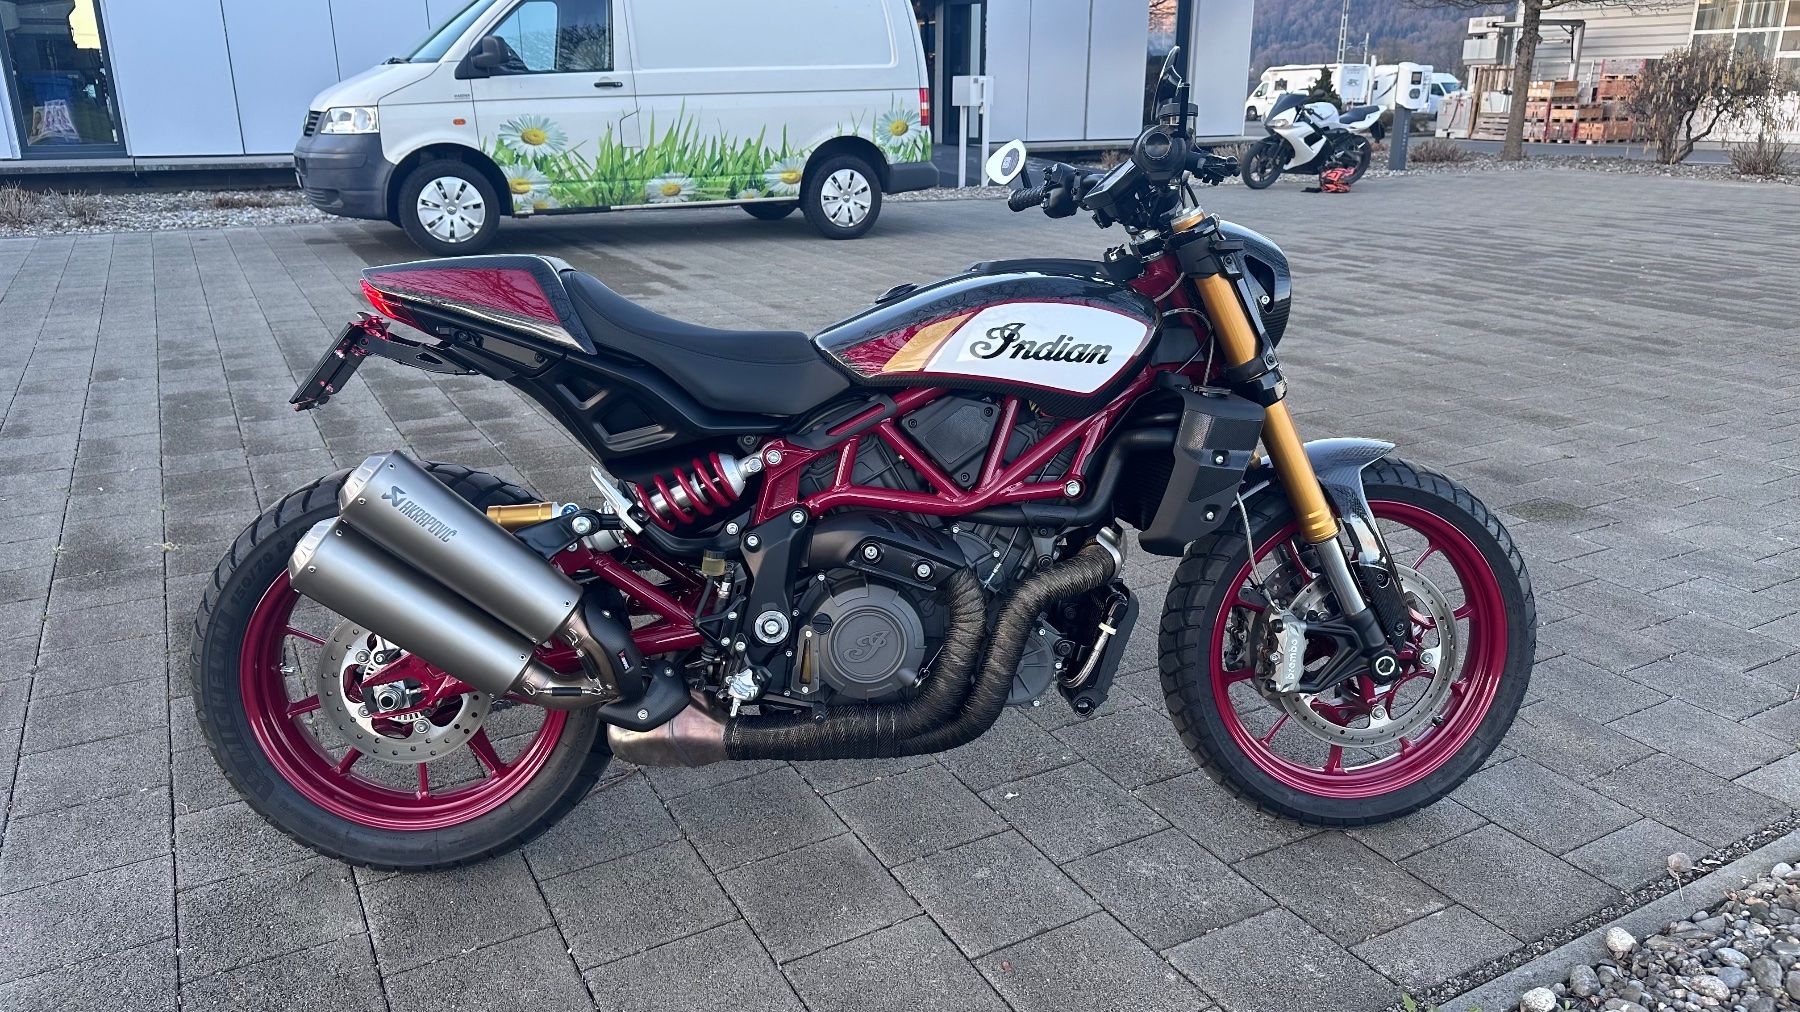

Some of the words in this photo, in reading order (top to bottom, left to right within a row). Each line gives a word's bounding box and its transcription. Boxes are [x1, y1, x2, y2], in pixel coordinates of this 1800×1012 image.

[969, 322, 1113, 365] Indian
[1286, 639, 1298, 680] brembo
[210, 619, 250, 764] MICHELIN
